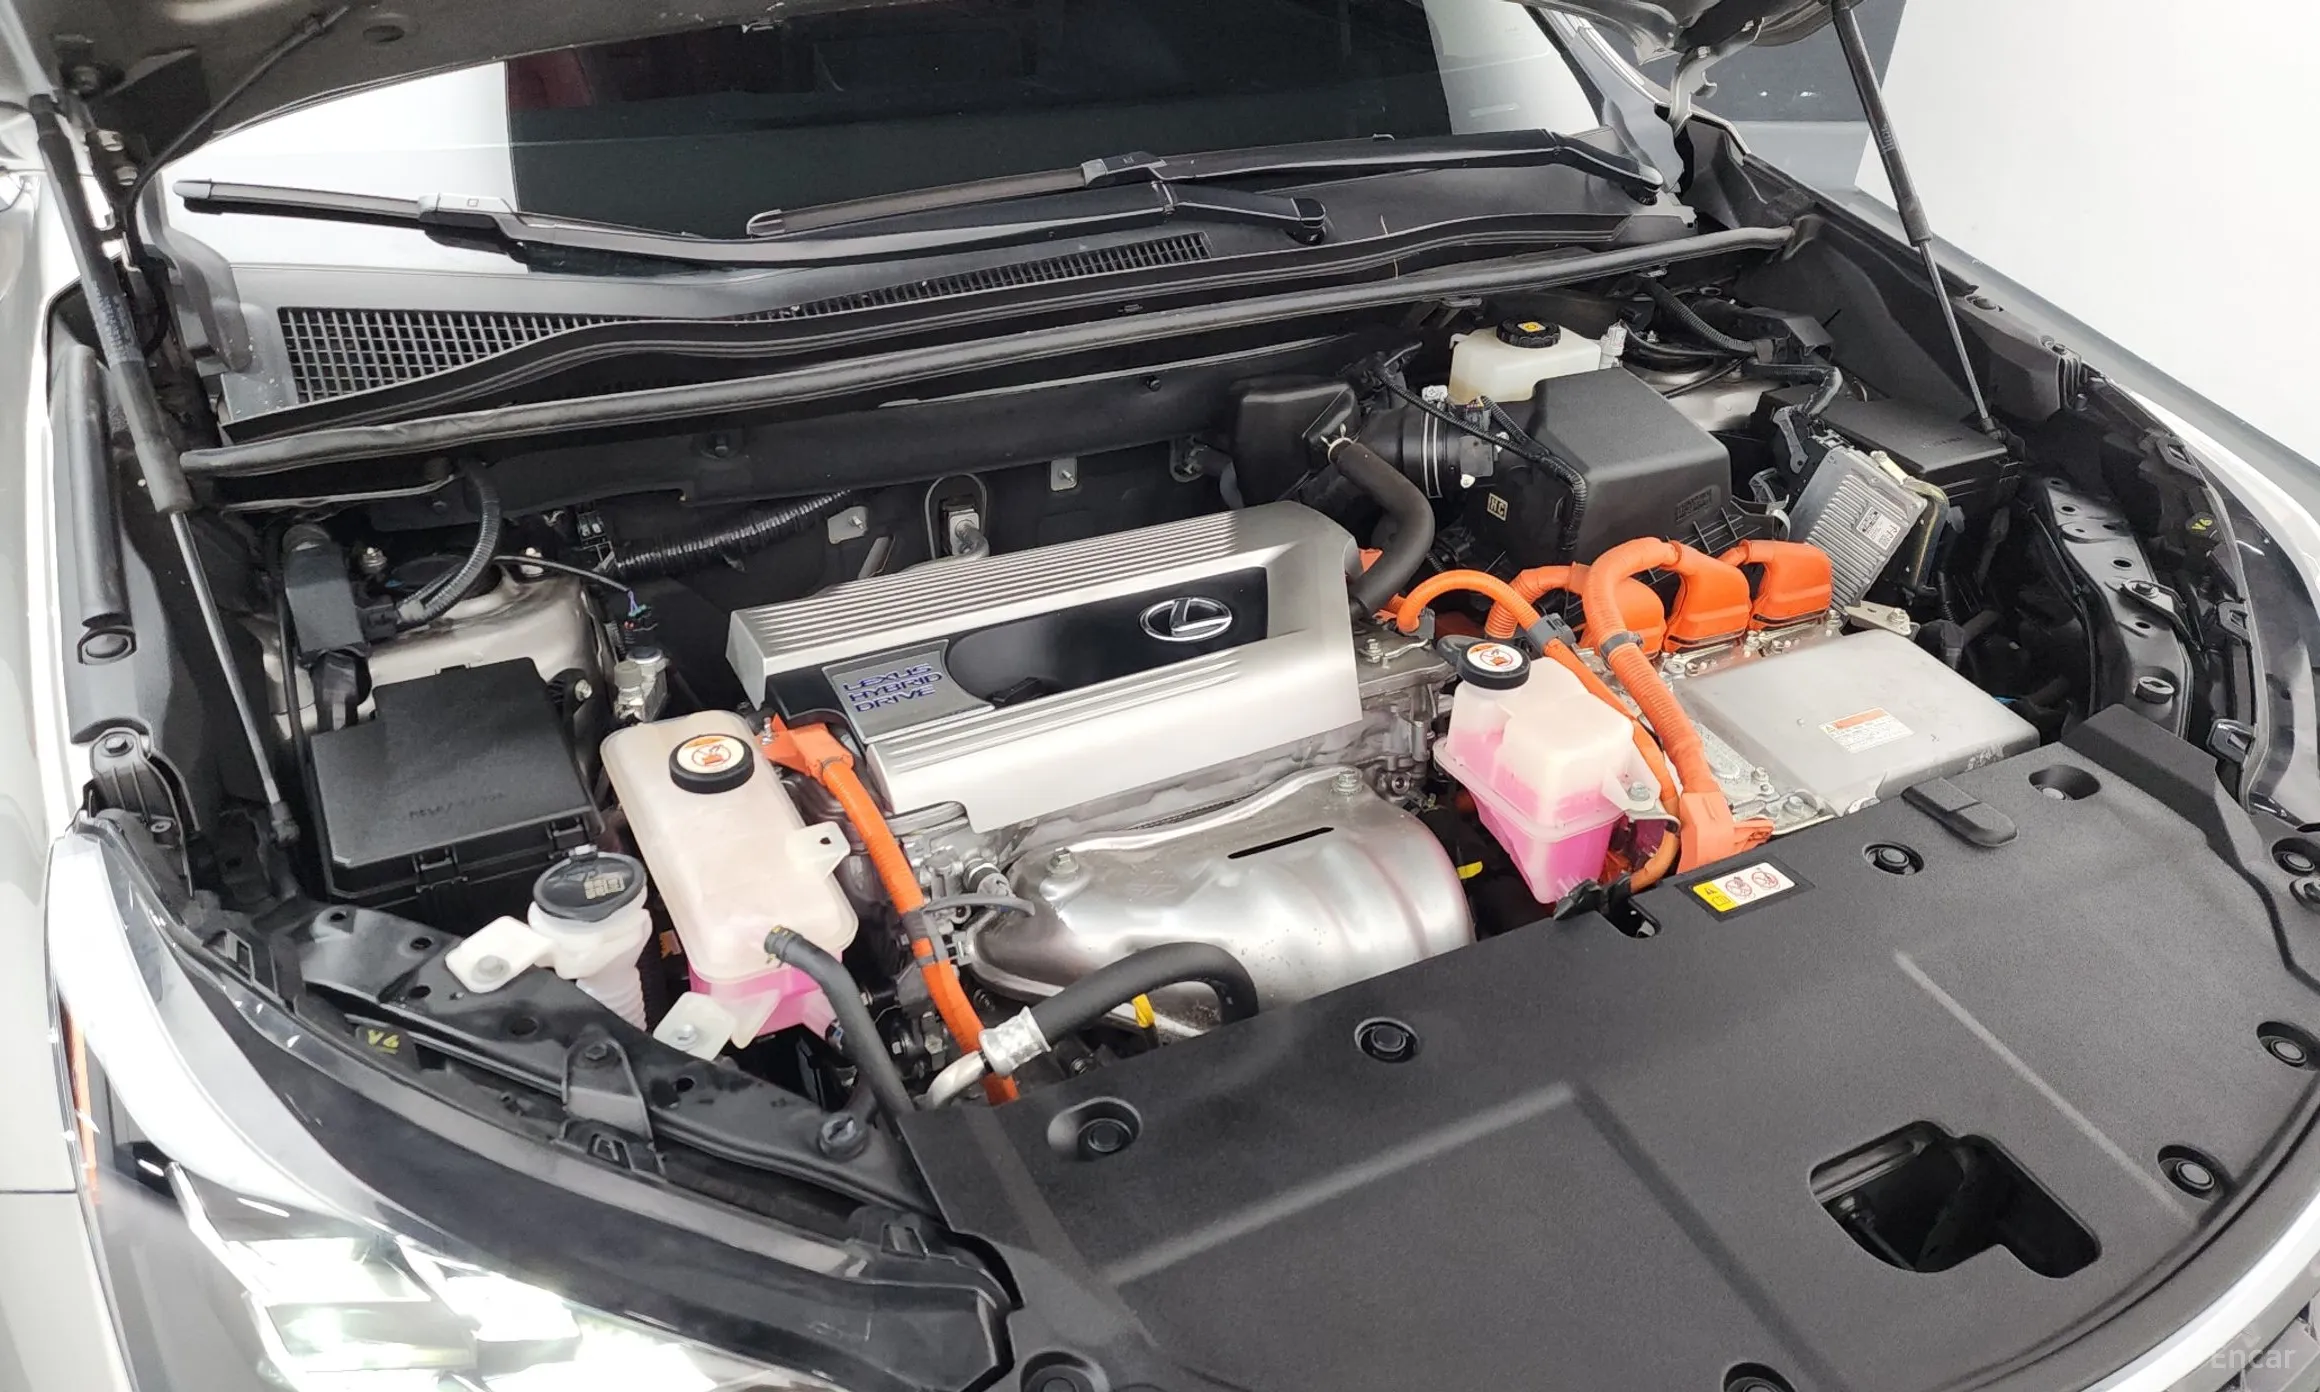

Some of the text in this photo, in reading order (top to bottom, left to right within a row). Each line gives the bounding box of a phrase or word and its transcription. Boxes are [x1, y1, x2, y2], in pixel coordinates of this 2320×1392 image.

[843, 662, 932, 691] LEXUS
[849, 672, 943, 702] HYBRID
[855, 684, 936, 713] DRIVE
